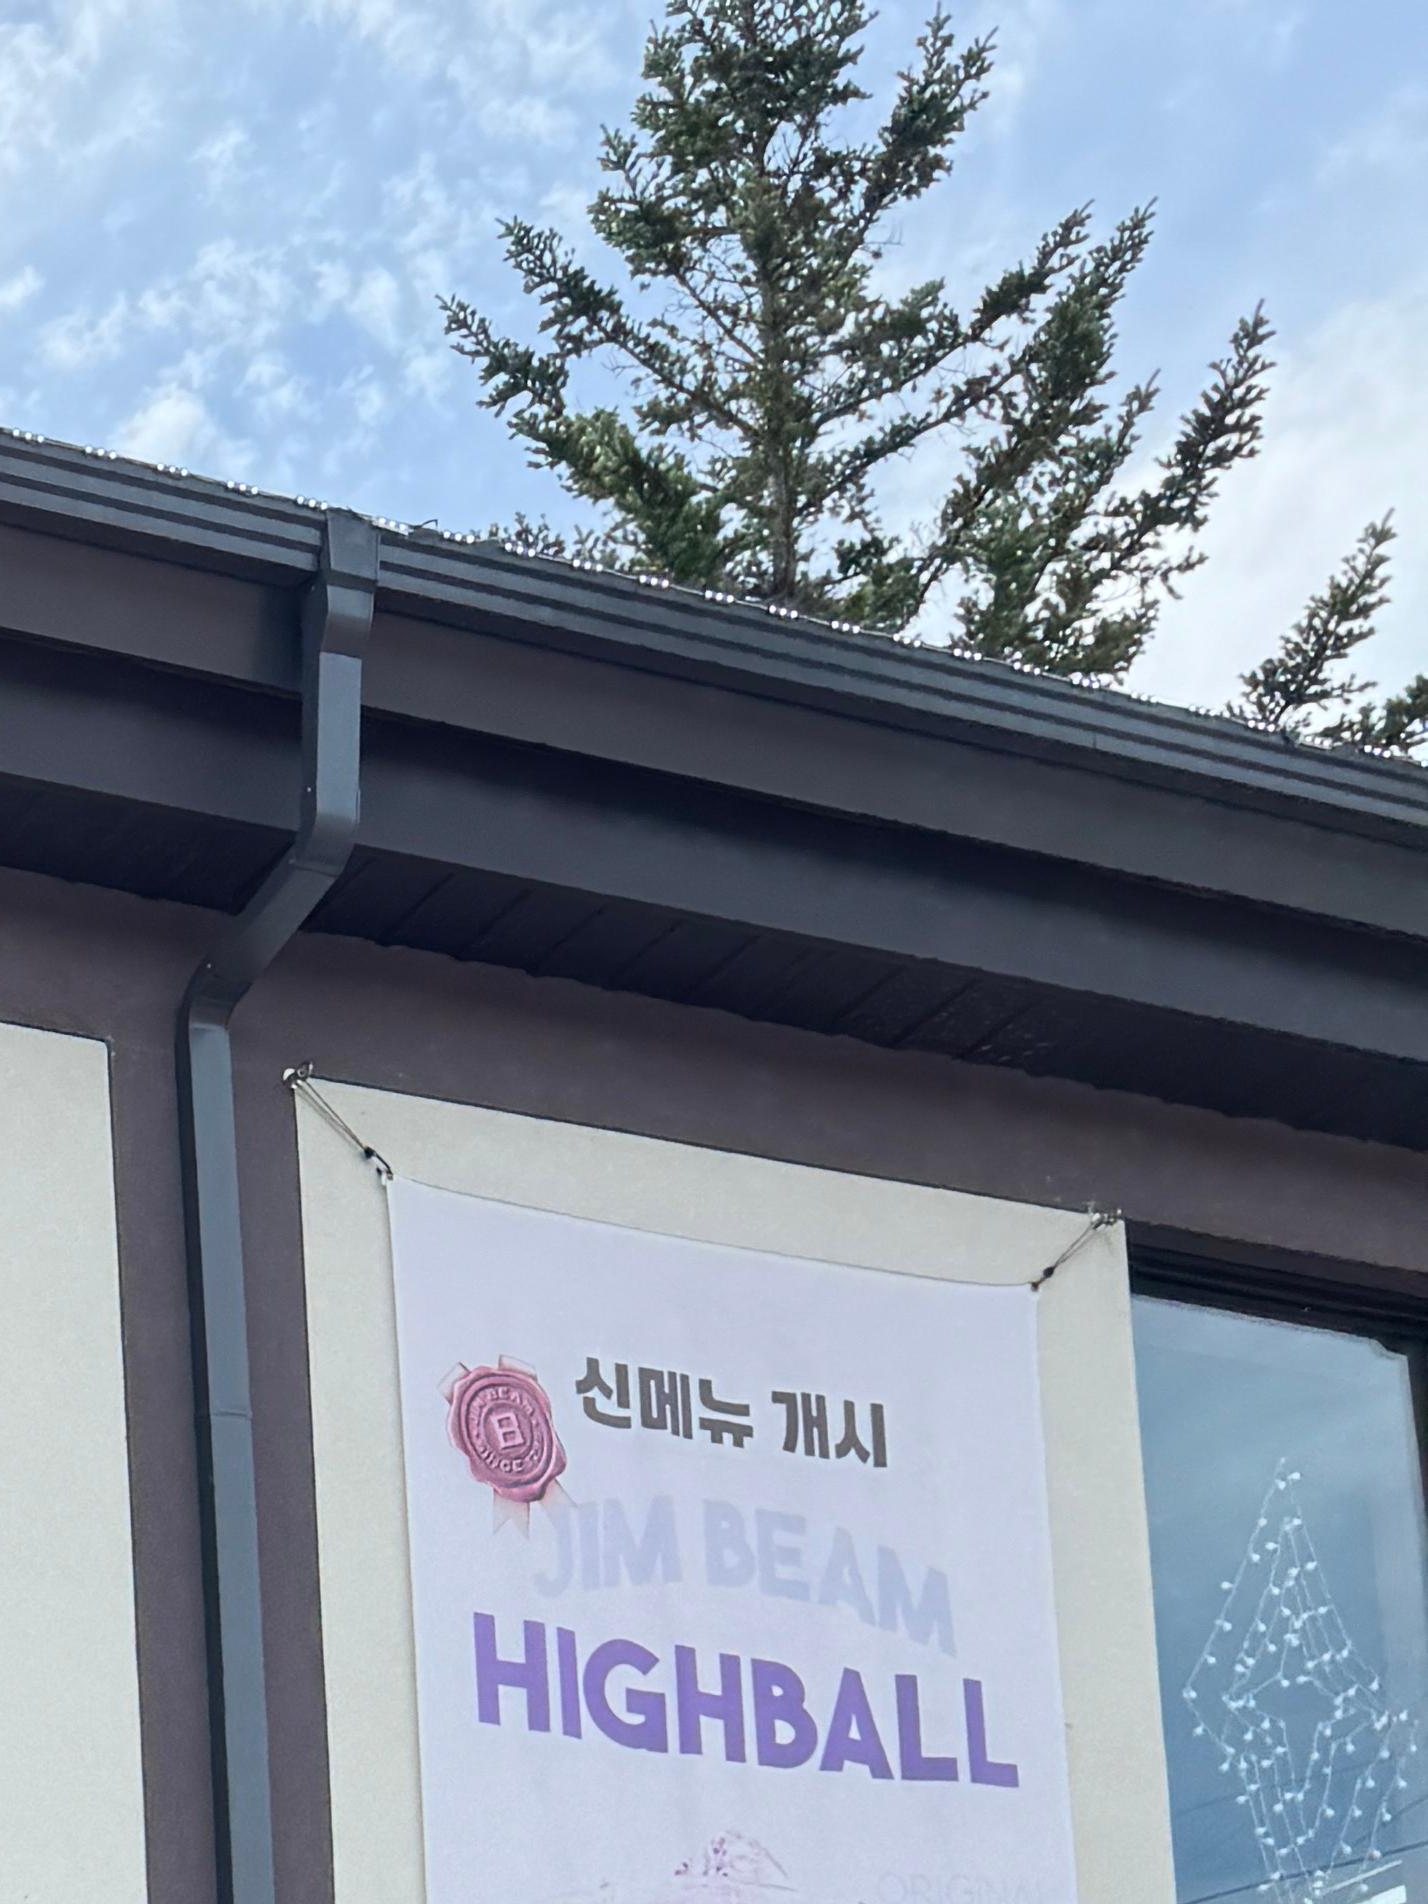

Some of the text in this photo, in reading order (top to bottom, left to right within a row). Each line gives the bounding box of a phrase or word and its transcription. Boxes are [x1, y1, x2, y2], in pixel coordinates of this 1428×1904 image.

[575, 1356, 888, 1468] 신메뉴 개시
[533, 1494, 958, 1659] JIM BEAM
[472, 1611, 1021, 1789] HIGHBALL
